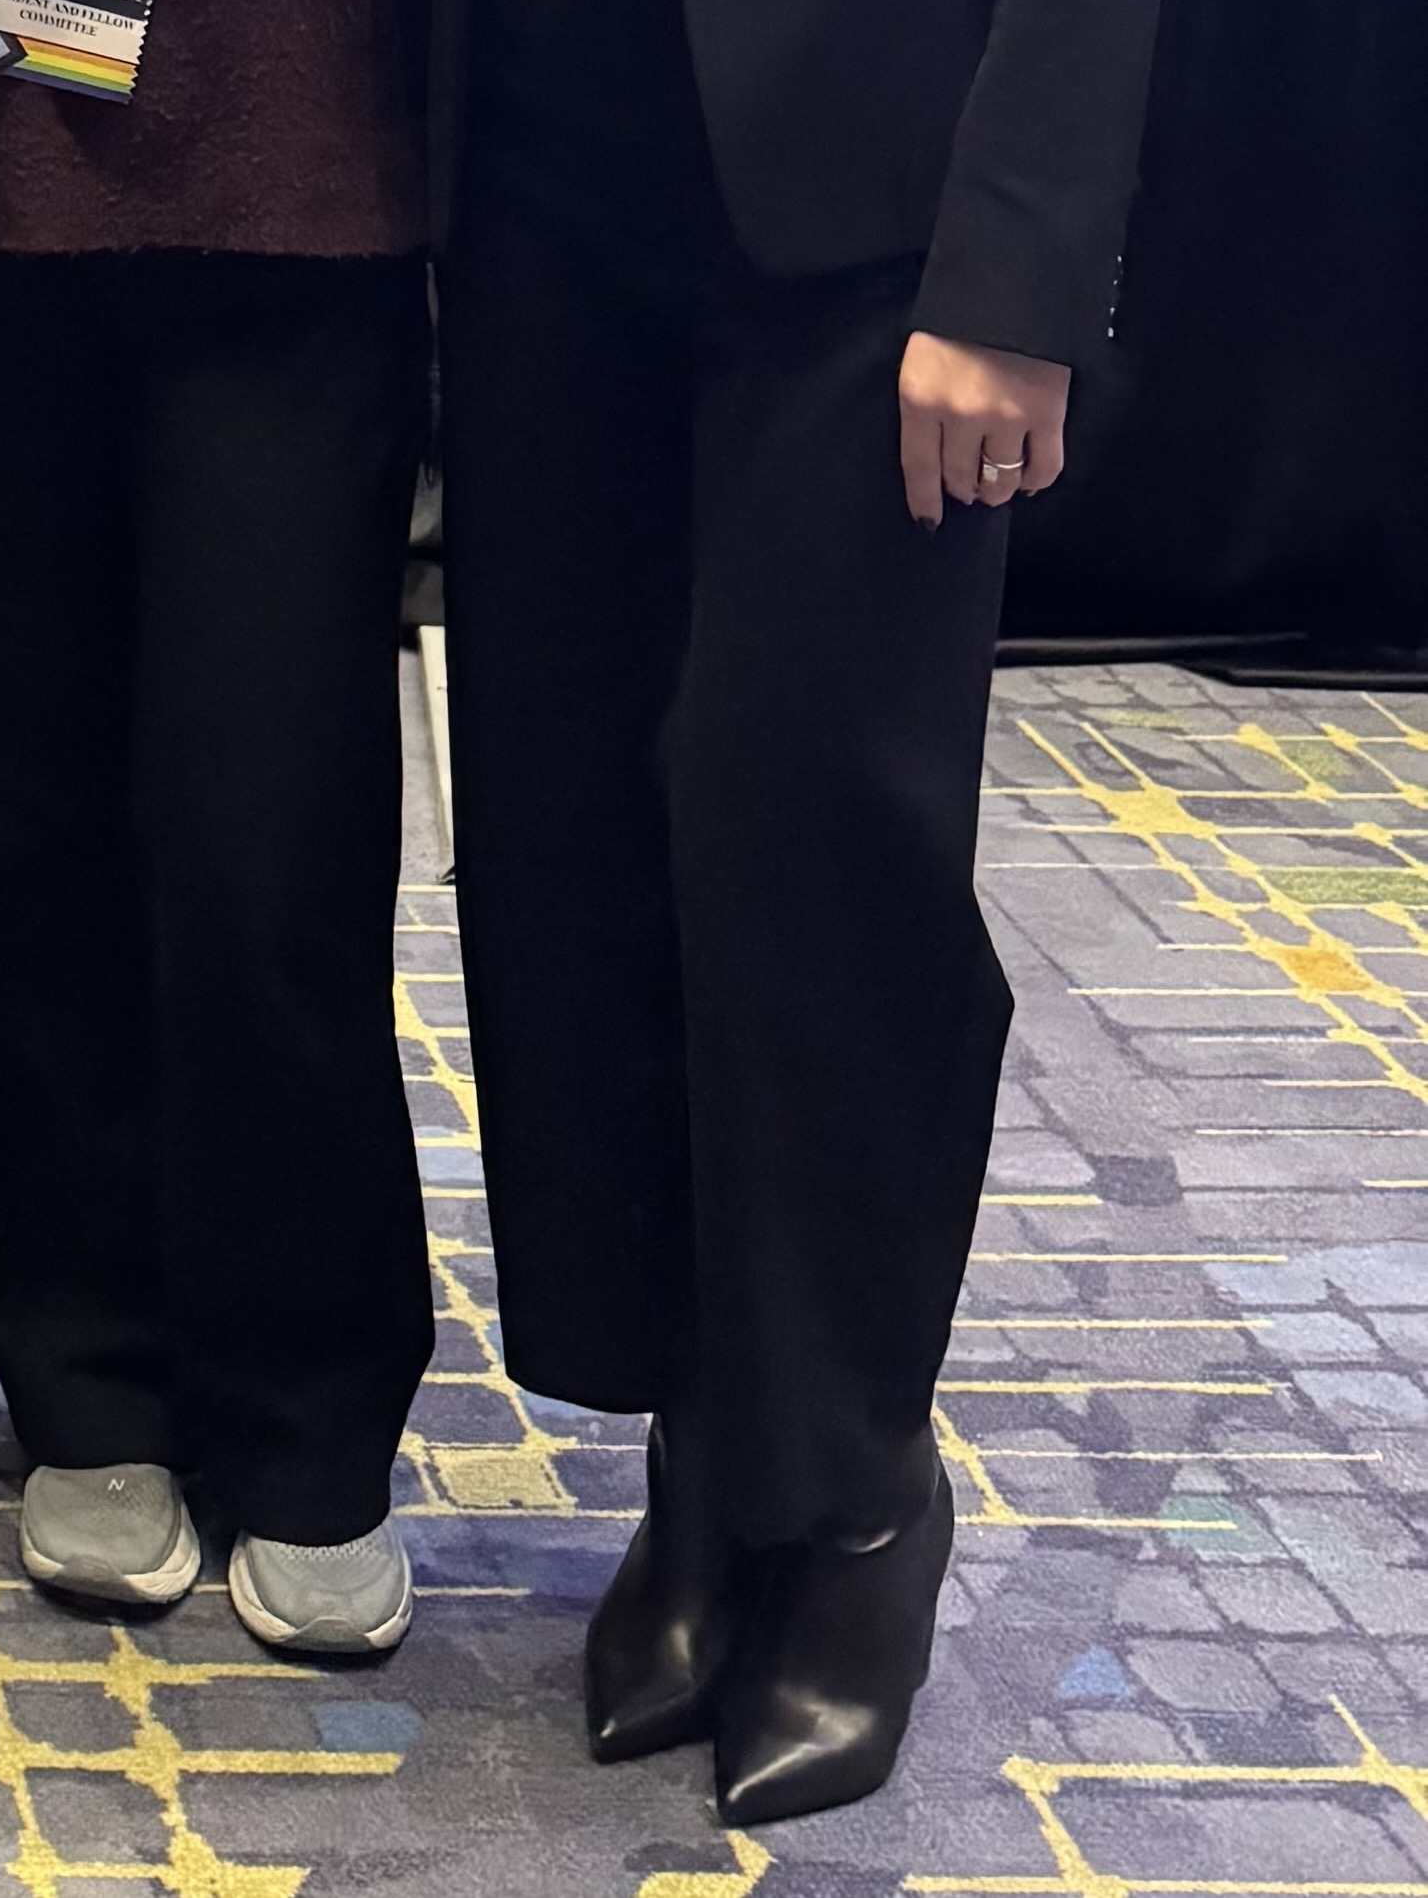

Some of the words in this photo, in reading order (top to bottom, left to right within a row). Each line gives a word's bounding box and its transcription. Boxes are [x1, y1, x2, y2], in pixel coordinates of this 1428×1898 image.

[19, 10, 98, 37] COMMITTEE
[54, 0, 80, 17] AND
[81, 6, 137, 31] FELLOW
